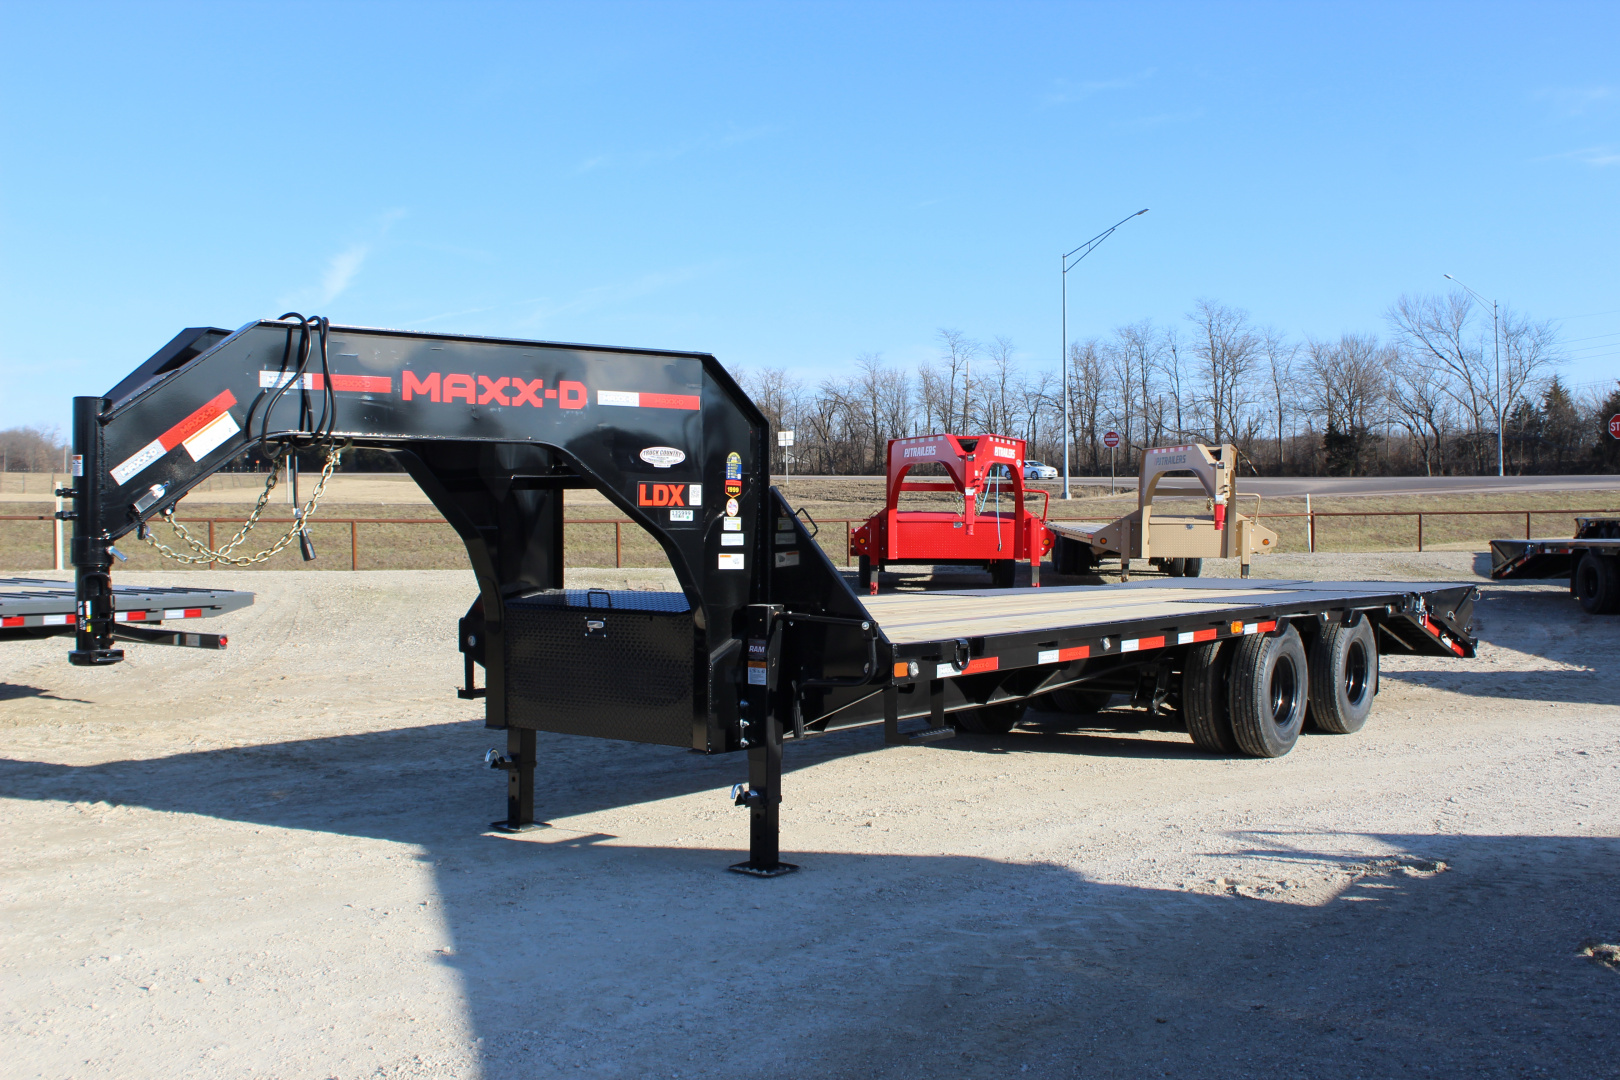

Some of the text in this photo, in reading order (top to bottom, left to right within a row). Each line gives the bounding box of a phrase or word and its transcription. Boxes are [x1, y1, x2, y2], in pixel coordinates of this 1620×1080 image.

[402, 370, 587, 410] MAXX-D
[119, 447, 158, 477] MAXX-D
[639, 483, 685, 507] LDX
[748, 645, 765, 653] RAM
